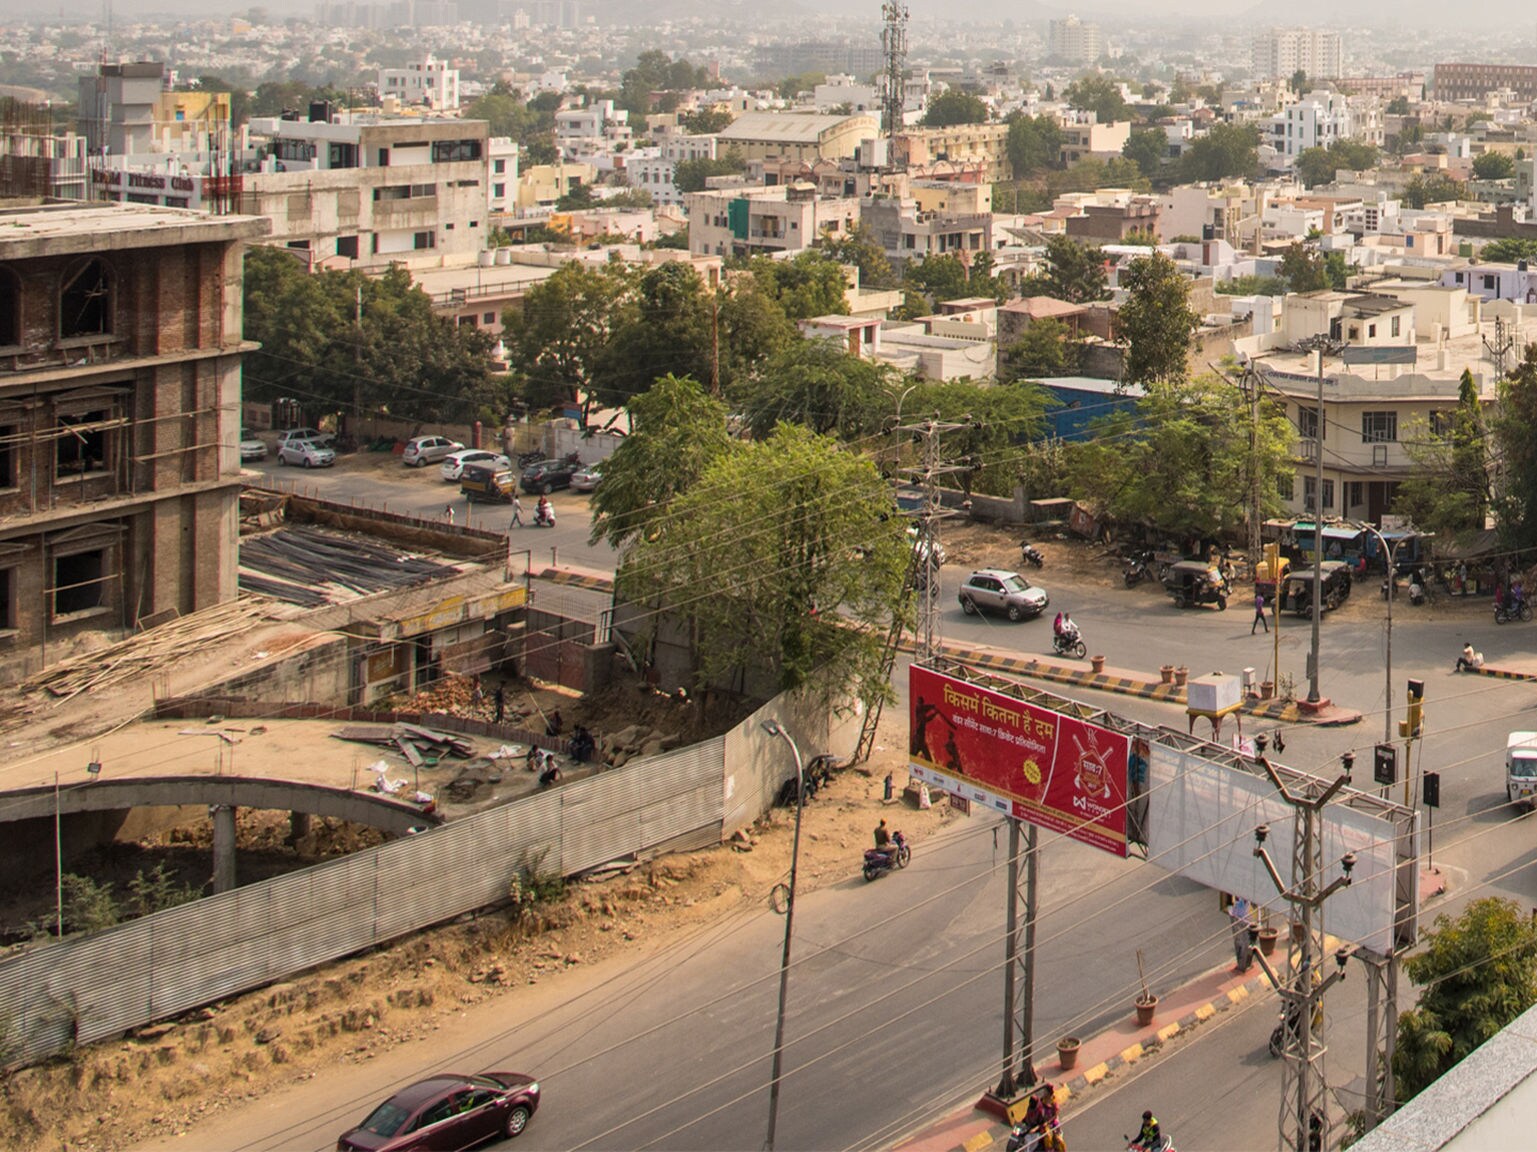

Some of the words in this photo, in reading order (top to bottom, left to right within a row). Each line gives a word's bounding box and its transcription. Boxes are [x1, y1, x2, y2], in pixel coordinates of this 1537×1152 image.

[128, 173, 165, 189] Fitness
[171, 176, 194, 191] Club
[943, 683, 979, 714] किसमें
[982, 696, 1021, 728] कितना
[1023, 709, 1033, 735] है
[1034, 719, 1054, 739] दम
